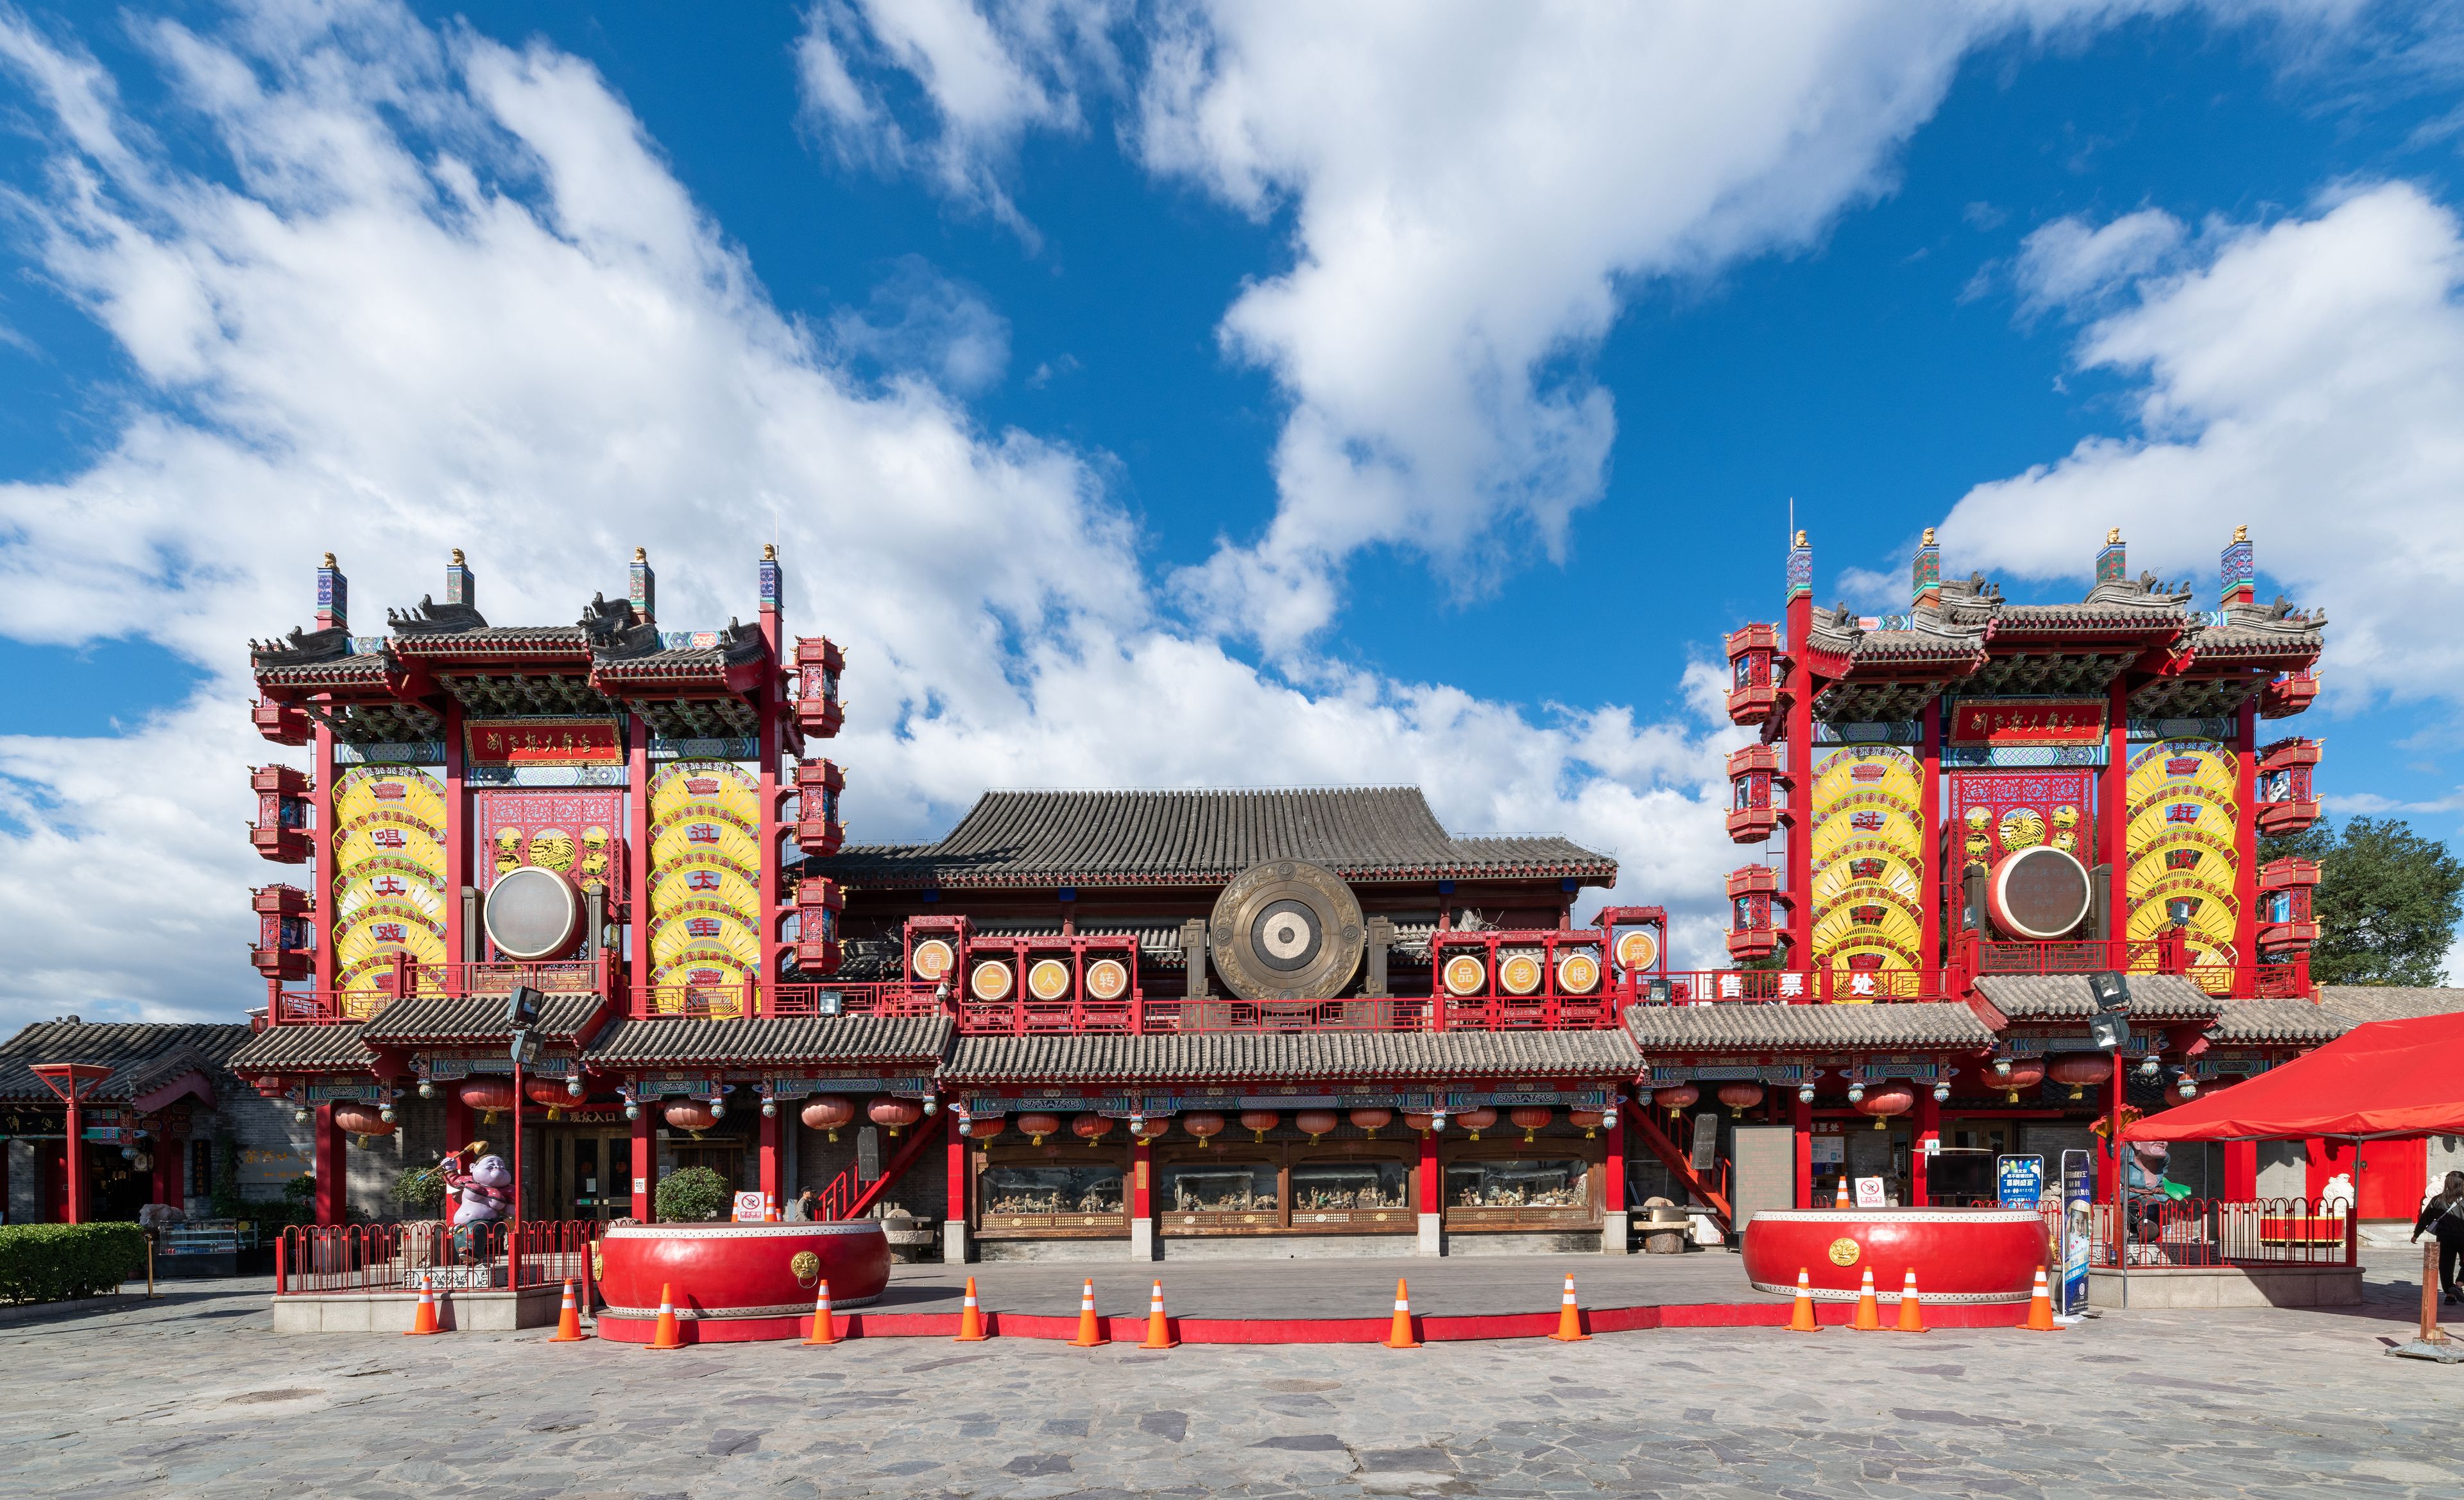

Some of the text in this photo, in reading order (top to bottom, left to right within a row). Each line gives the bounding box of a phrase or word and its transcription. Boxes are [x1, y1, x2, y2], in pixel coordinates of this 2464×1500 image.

[375, 828, 405, 944] 唱大戏
[689, 825, 719, 938] 过大年
[1852, 812, 1883, 922] 过大年
[1718, 972, 1875, 998] 售票处
[569, 1111, 617, 1123] 观众入口
